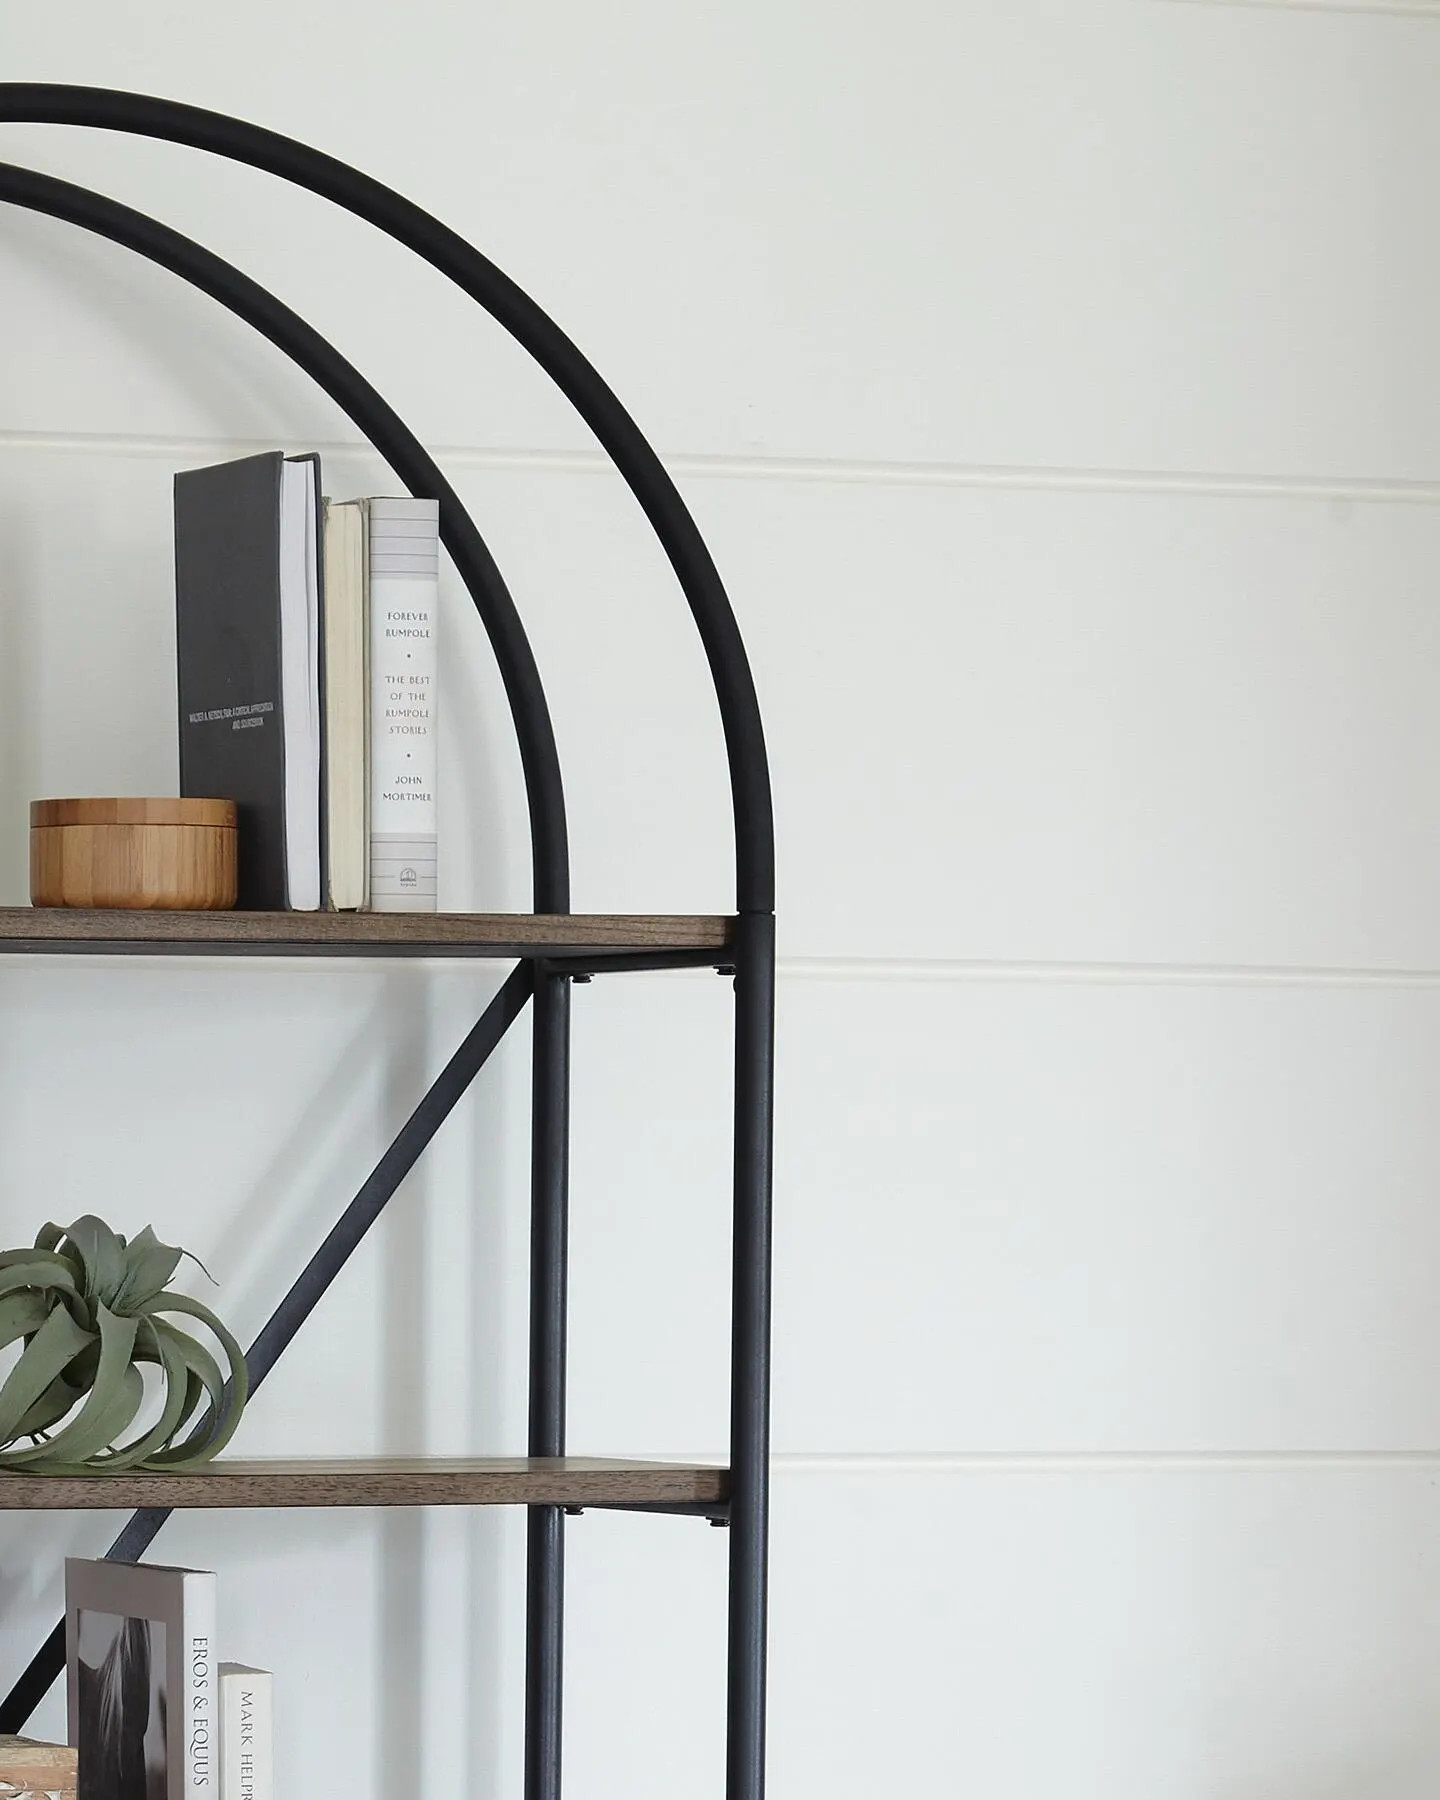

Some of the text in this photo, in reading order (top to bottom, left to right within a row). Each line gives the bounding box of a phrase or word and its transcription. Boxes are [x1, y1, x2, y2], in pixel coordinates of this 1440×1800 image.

[385, 676, 430, 684] THE BEST
[390, 692, 402, 701] OF
[389, 726, 427, 735] STORIES
[395, 776, 422, 784] JOHN
[383, 793, 432, 802] MORTIMER
[189, 1637, 209, 1786] EROS & EQUUS
[241, 1691, 253, 1746] MARK
